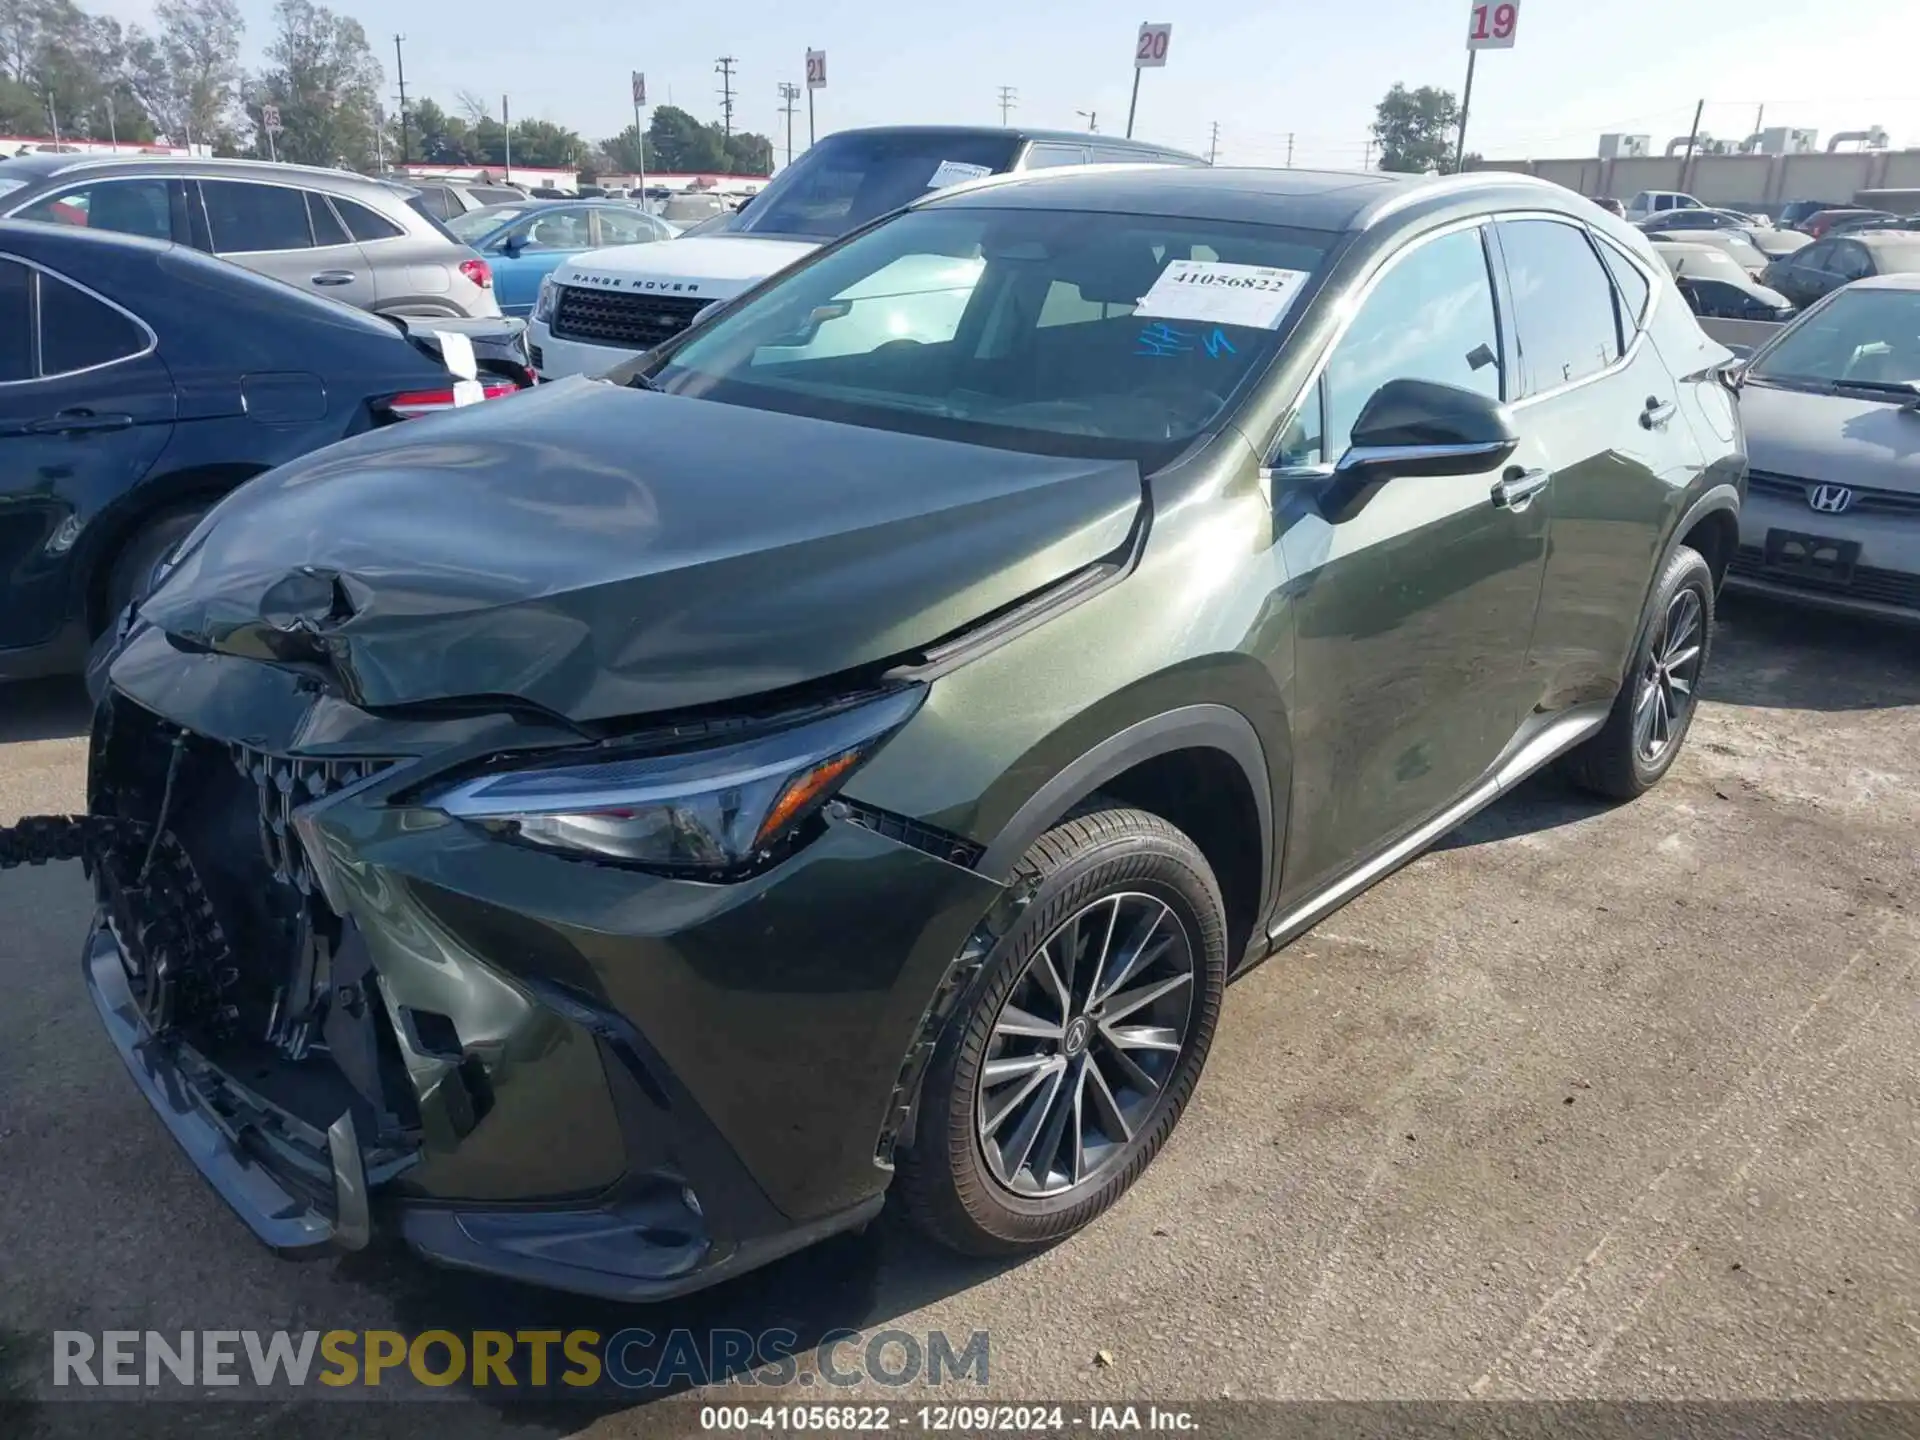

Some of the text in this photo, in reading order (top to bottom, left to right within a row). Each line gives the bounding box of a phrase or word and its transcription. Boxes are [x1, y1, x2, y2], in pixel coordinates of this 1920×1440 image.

[1470, 3, 1516, 39] 19
[1137, 31, 1168, 59] 20
[807, 58, 826, 82] 21
[573, 274, 700, 292] RANGE ROVER
[1172, 272, 1284, 292] 41056822
